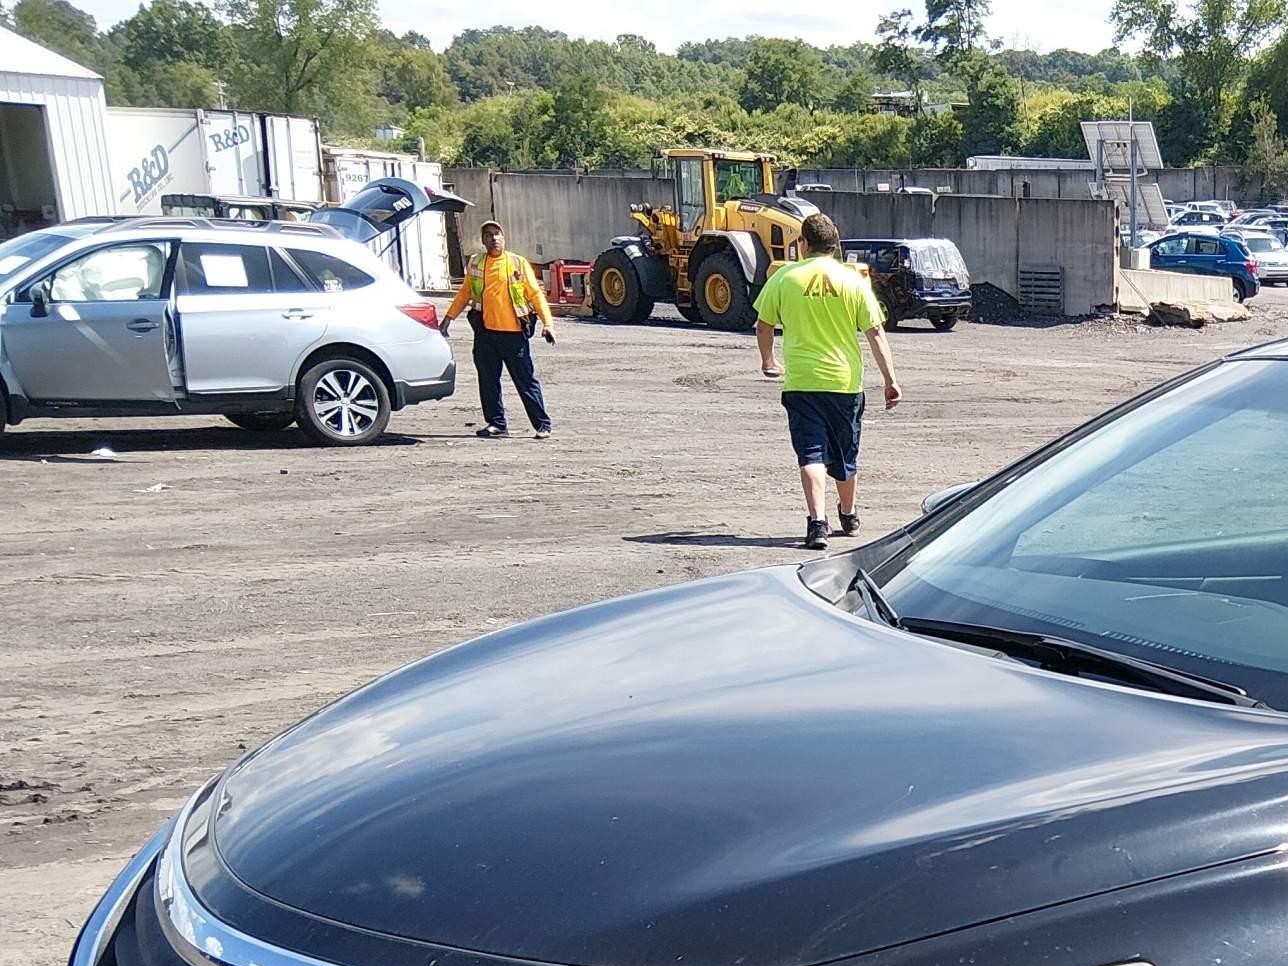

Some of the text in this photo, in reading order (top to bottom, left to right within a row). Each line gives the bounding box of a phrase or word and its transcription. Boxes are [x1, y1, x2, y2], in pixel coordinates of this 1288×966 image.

[209, 125, 250, 152] R&D
[127, 144, 169, 204] R&D
[345, 173, 369, 183] 9267
